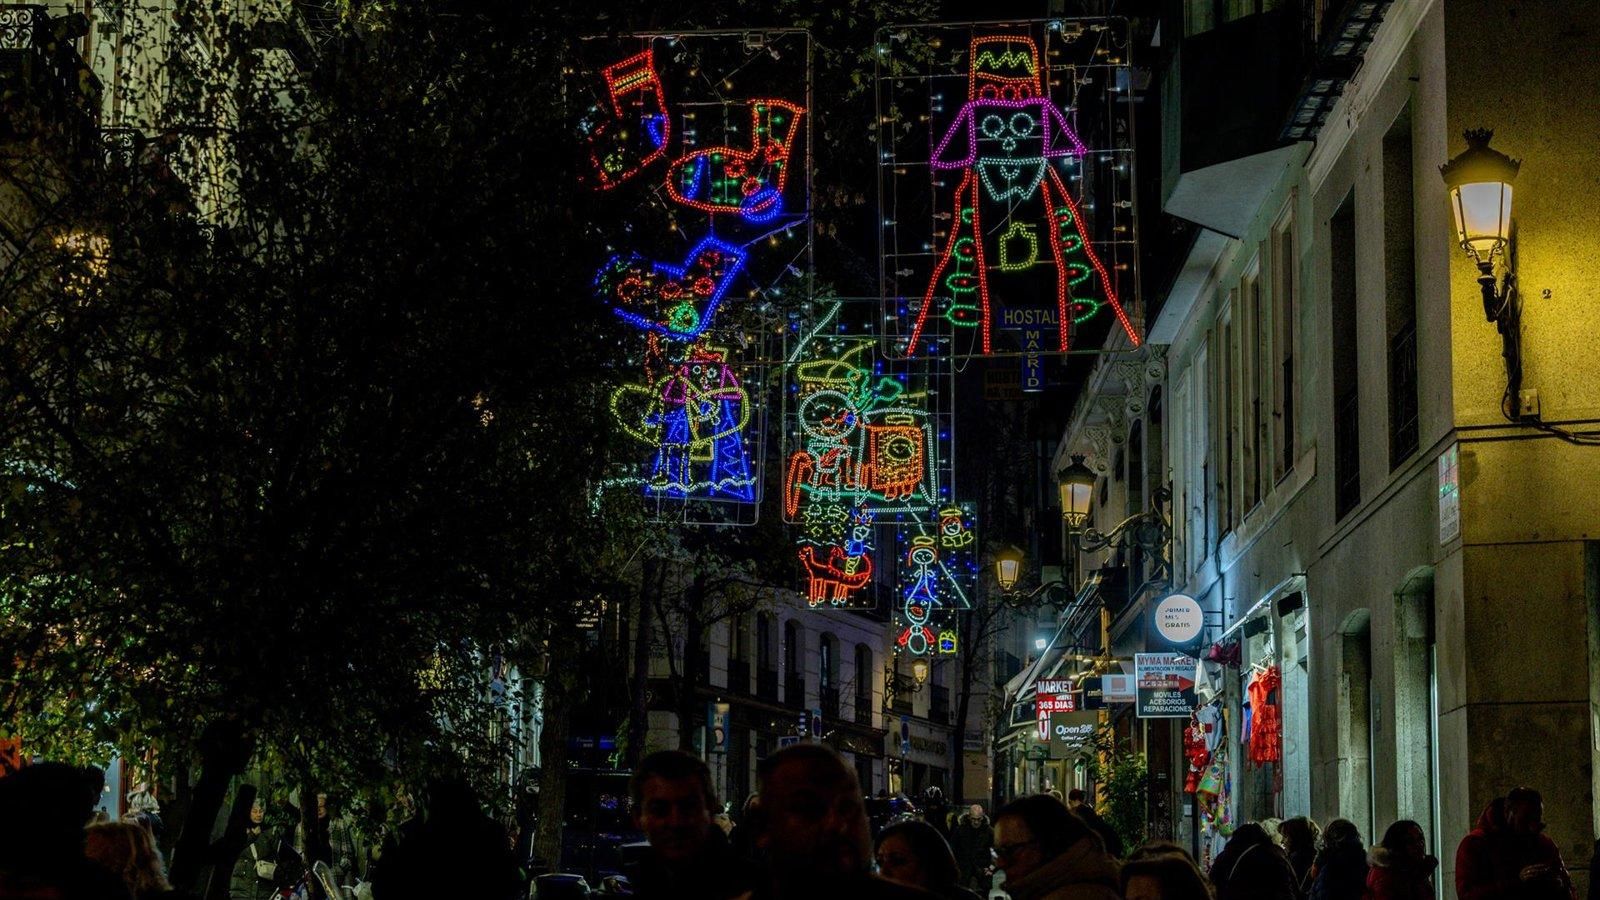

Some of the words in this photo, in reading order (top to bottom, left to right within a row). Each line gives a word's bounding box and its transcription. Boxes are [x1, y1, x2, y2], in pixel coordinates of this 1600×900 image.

[1542, 288, 1552, 300] 2
[1004, 309, 1059, 325] HOSTAL
[1026, 330, 1040, 387] MADRID
[1138, 656, 1162, 666] MYMA
[1038, 680, 1073, 693] MARKET
[1038, 701, 1054, 709] 365
[1055, 700, 1074, 709] DIAS
[1143, 705, 1192, 713] REPARACIONES
[1055, 725, 1080, 735] Open
